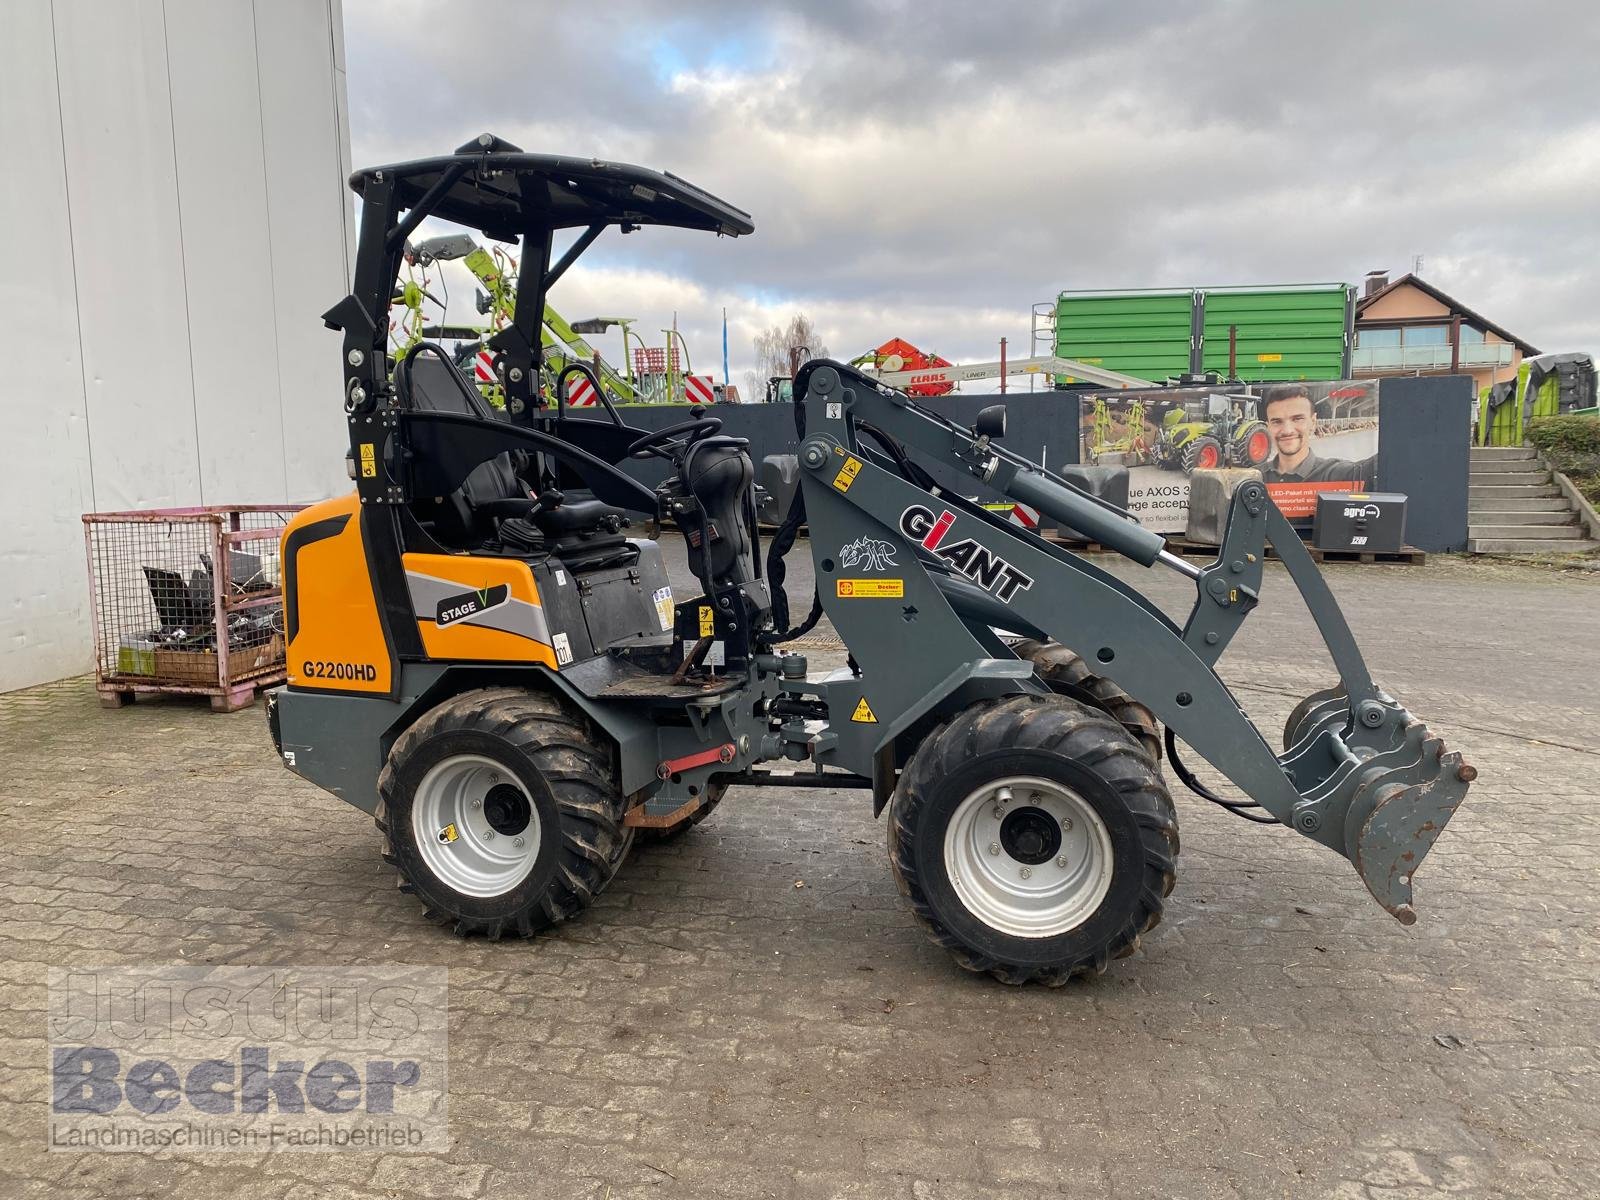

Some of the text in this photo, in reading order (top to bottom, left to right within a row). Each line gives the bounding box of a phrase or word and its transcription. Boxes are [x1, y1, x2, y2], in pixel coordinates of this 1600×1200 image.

[911, 373, 946, 383] CLAAS
[966, 371, 986, 379] LINER
[1146, 486, 1180, 497] AXOS
[1343, 507, 1366, 518] agro
[441, 601, 477, 622] STAGE
[303, 661, 377, 681] G2200HD
